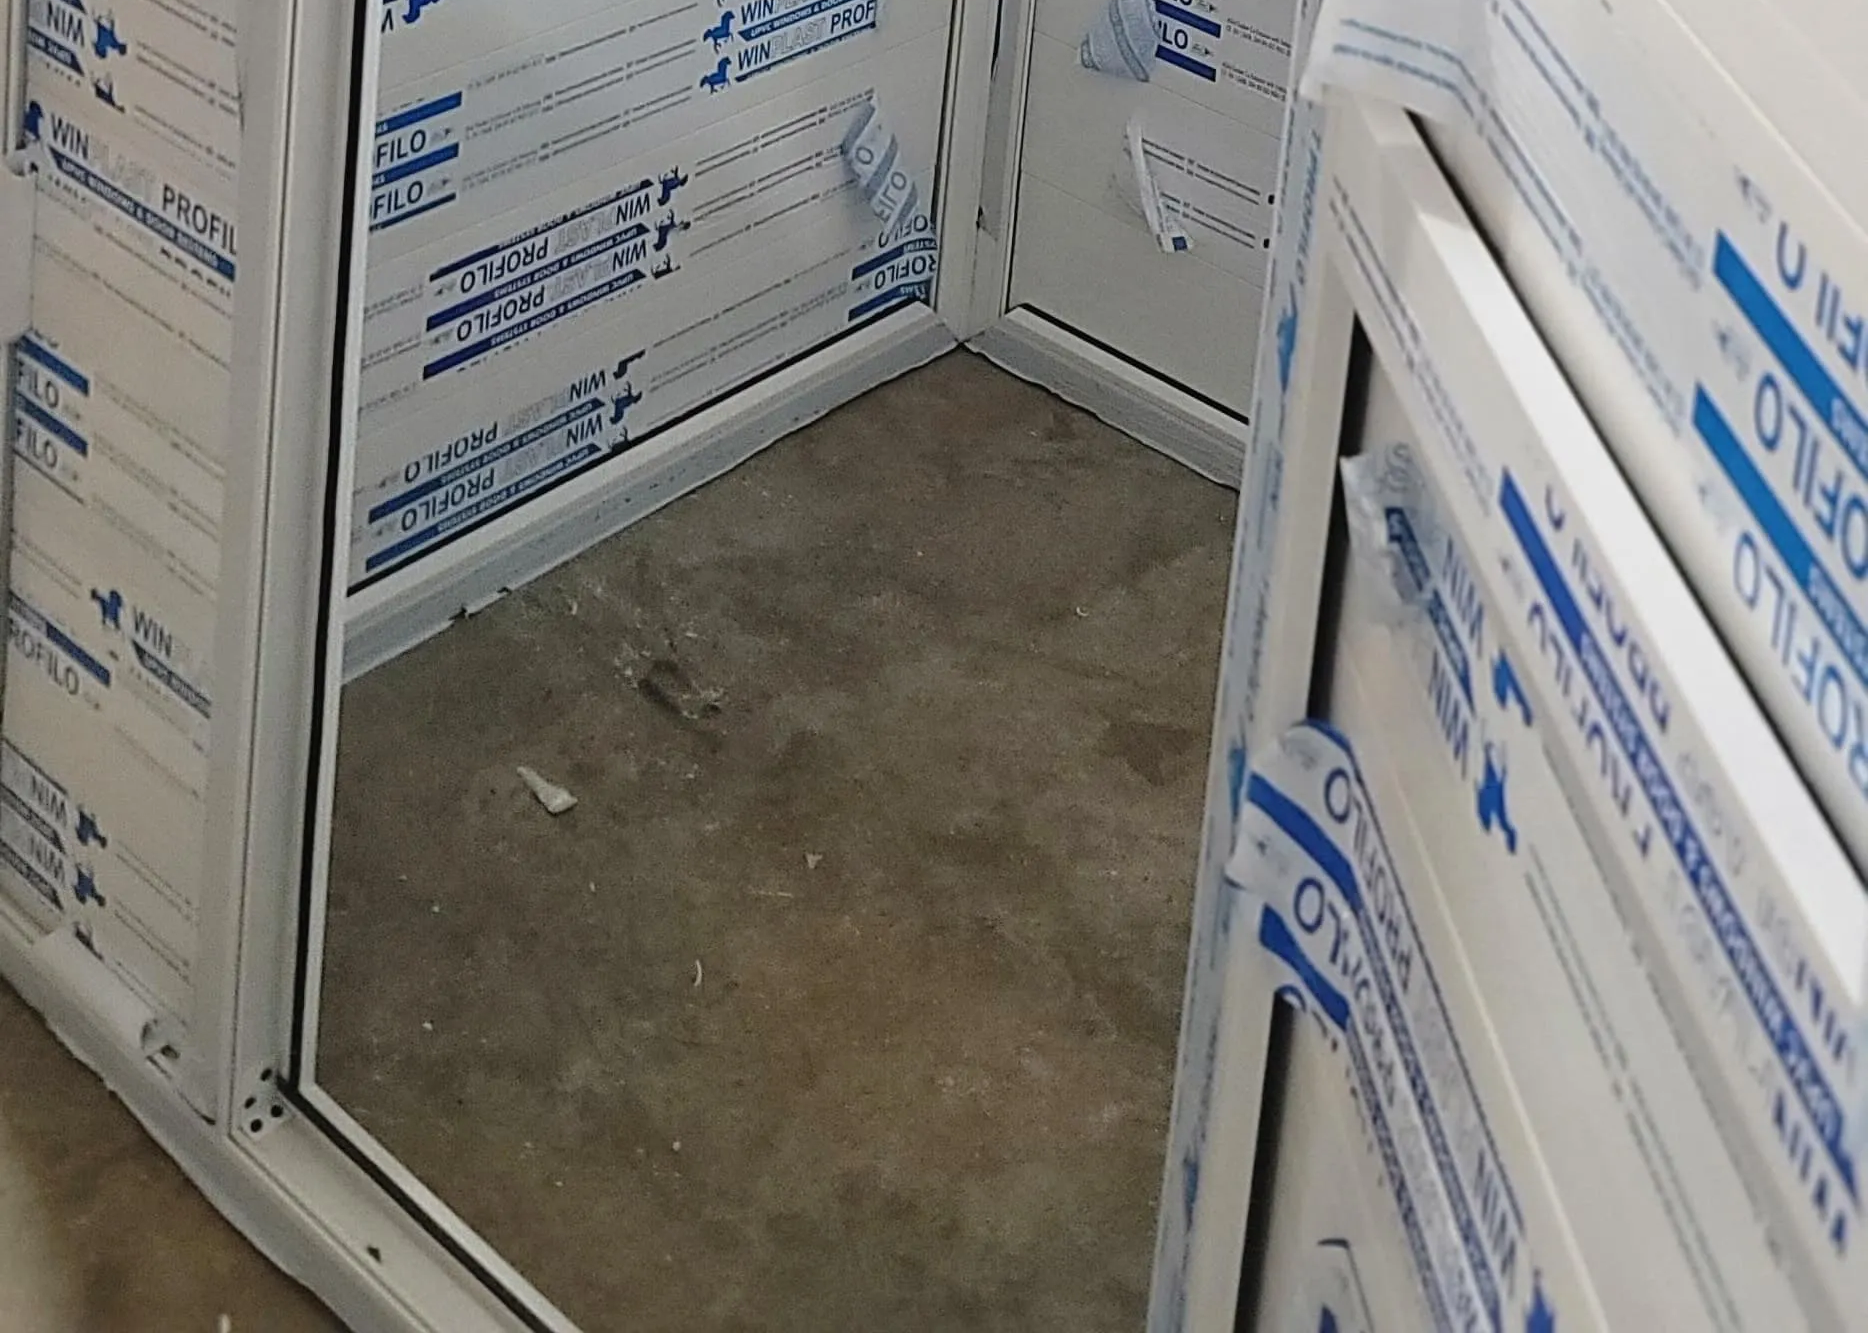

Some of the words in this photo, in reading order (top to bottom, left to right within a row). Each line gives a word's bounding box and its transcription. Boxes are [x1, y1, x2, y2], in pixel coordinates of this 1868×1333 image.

[460, 238, 549, 293] PROFILO
[457, 286, 545, 340] PROFILO
[405, 423, 497, 483] PROFILO
[402, 469, 494, 531] PROFILO
